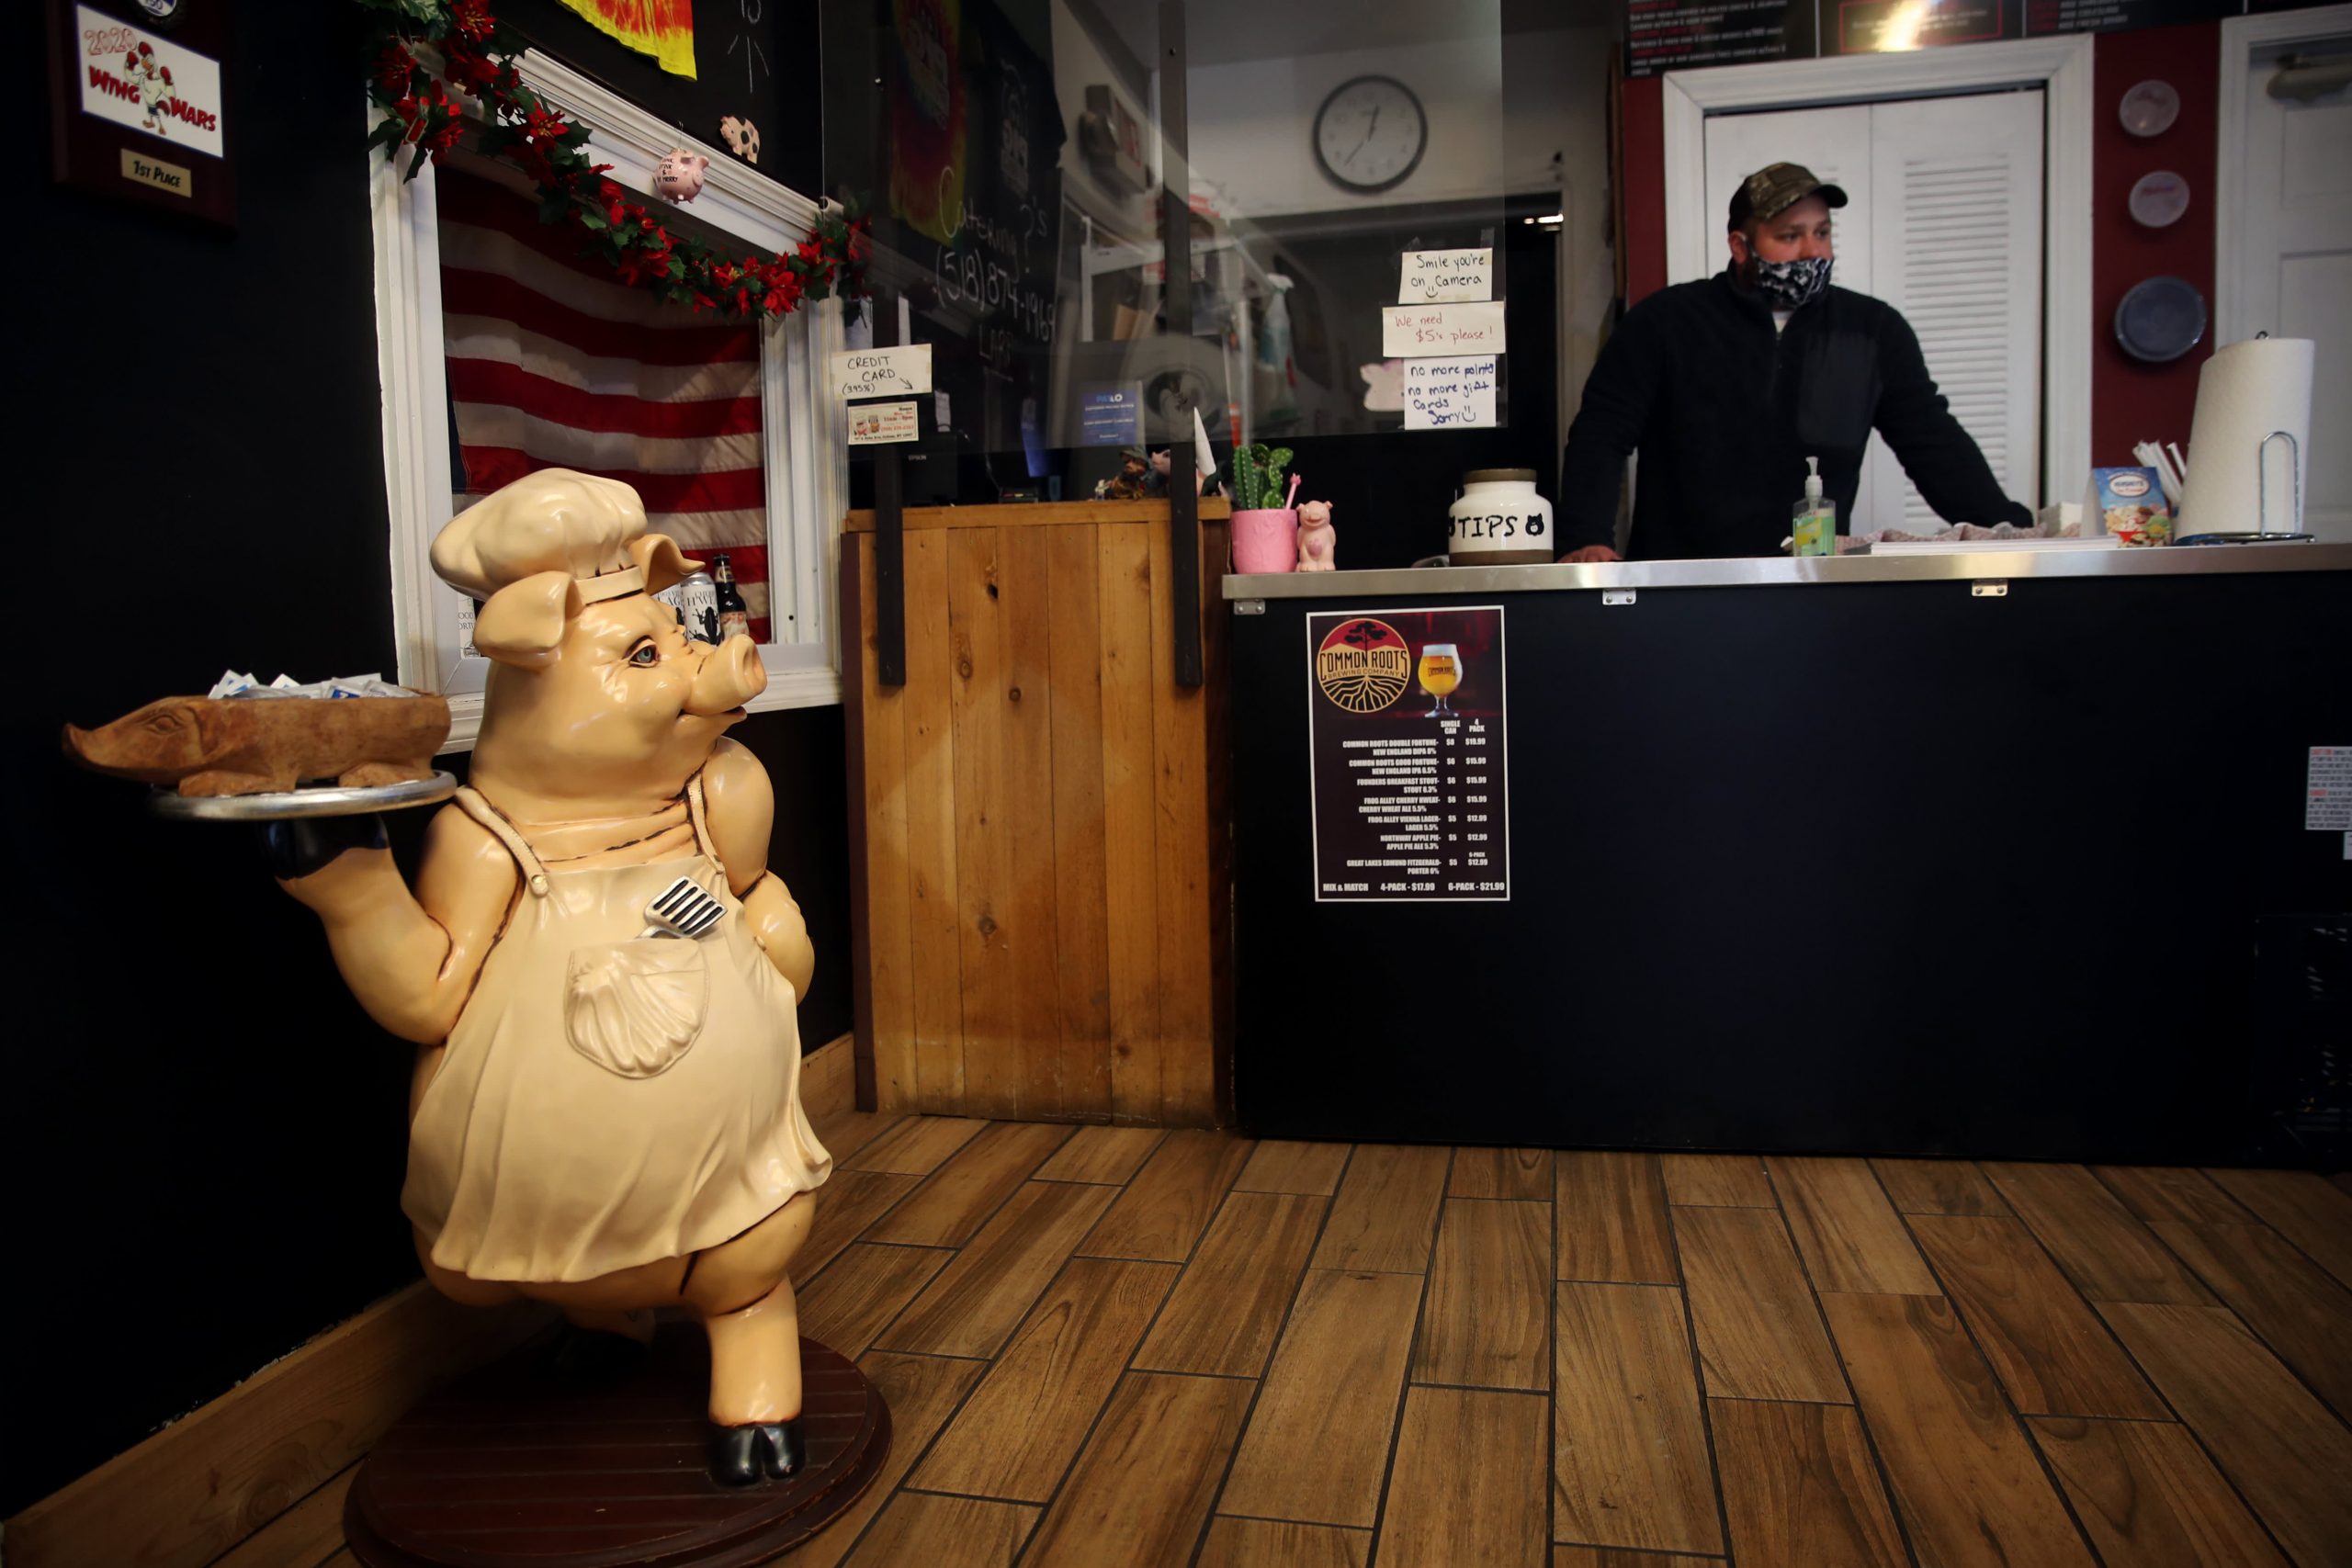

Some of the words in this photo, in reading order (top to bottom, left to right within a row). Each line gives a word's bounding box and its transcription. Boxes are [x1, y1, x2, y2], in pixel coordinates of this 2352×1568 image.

[85, 28, 138, 55] 2020
[1417, 255, 1449, 269] Smile
[1453, 254, 1484, 272] you're
[937, 244, 985, 312] (518)
[1411, 276, 1425, 288] on
[1395, 316, 1412, 327] We
[1420, 312, 1442, 325] need
[847, 356, 890, 369] CREDIT
[862, 369, 896, 382] CARD
[1411, 367, 1425, 377] no
[1431, 367, 1460, 377] more
[1464, 364, 1494, 379] points
[1408, 388, 1421, 396] no
[1430, 384, 1458, 396] more
[1463, 381, 1489, 398] gift
[1458, 514, 1518, 538] TIPS
[1319, 651, 1368, 682] COMMON
[1371, 650, 1408, 679] ROOTS
[1329, 669, 1363, 679] BREWING
[1363, 669, 1400, 677] COMPANY
[1386, 748, 1412, 756] ENGLAND
[1396, 796, 1419, 805] CHERRY
[1402, 805, 1411, 813] ALE
[1323, 884, 1337, 892] MIX
[1344, 883, 1369, 892] MATCH
[1380, 883, 1407, 891] 4-PACK
[1411, 883, 1435, 891] $17.99
[1448, 883, 1475, 891] 6-PACK
[1480, 882, 1505, 891] $21.99
